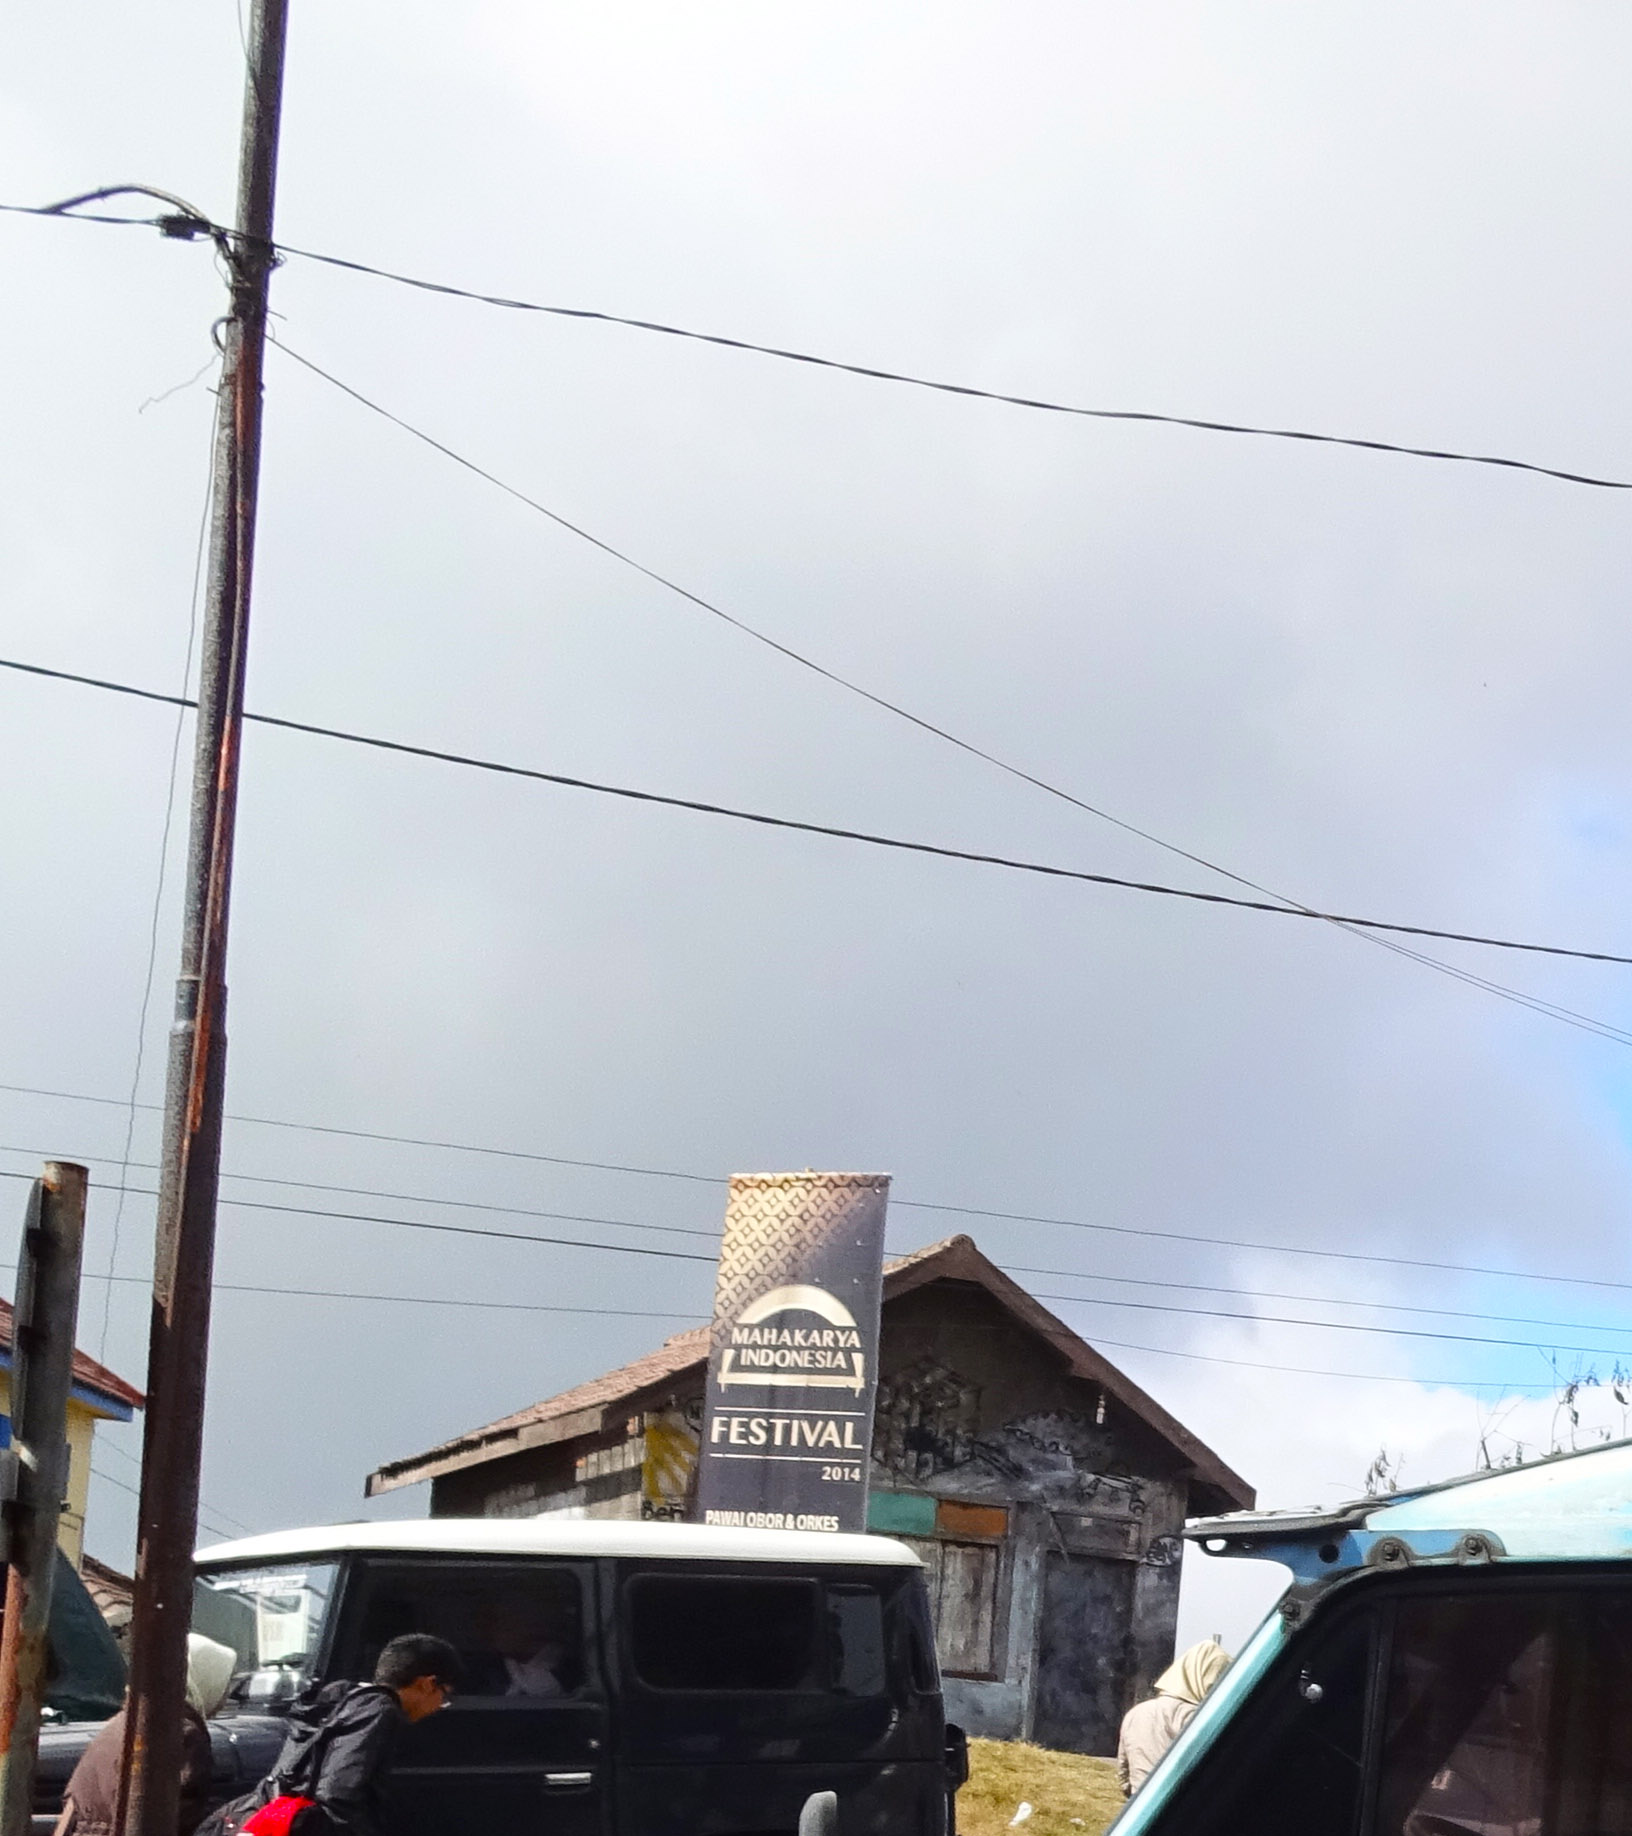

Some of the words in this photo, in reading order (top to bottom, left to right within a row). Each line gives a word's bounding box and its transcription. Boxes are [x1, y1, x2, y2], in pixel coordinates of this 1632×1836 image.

[731, 1327, 861, 1349] MAHAKARYA
[740, 1349, 847, 1369] INDONESIA
[710, 1416, 864, 1450] FESTIVAL
[821, 1466, 861, 1482] 2014
[705, 1510, 745, 1526] PAWAI
[746, 1512, 783, 1529] OBOR
[785, 1513, 795, 1530] &
[796, 1514, 840, 1532] ORKES
